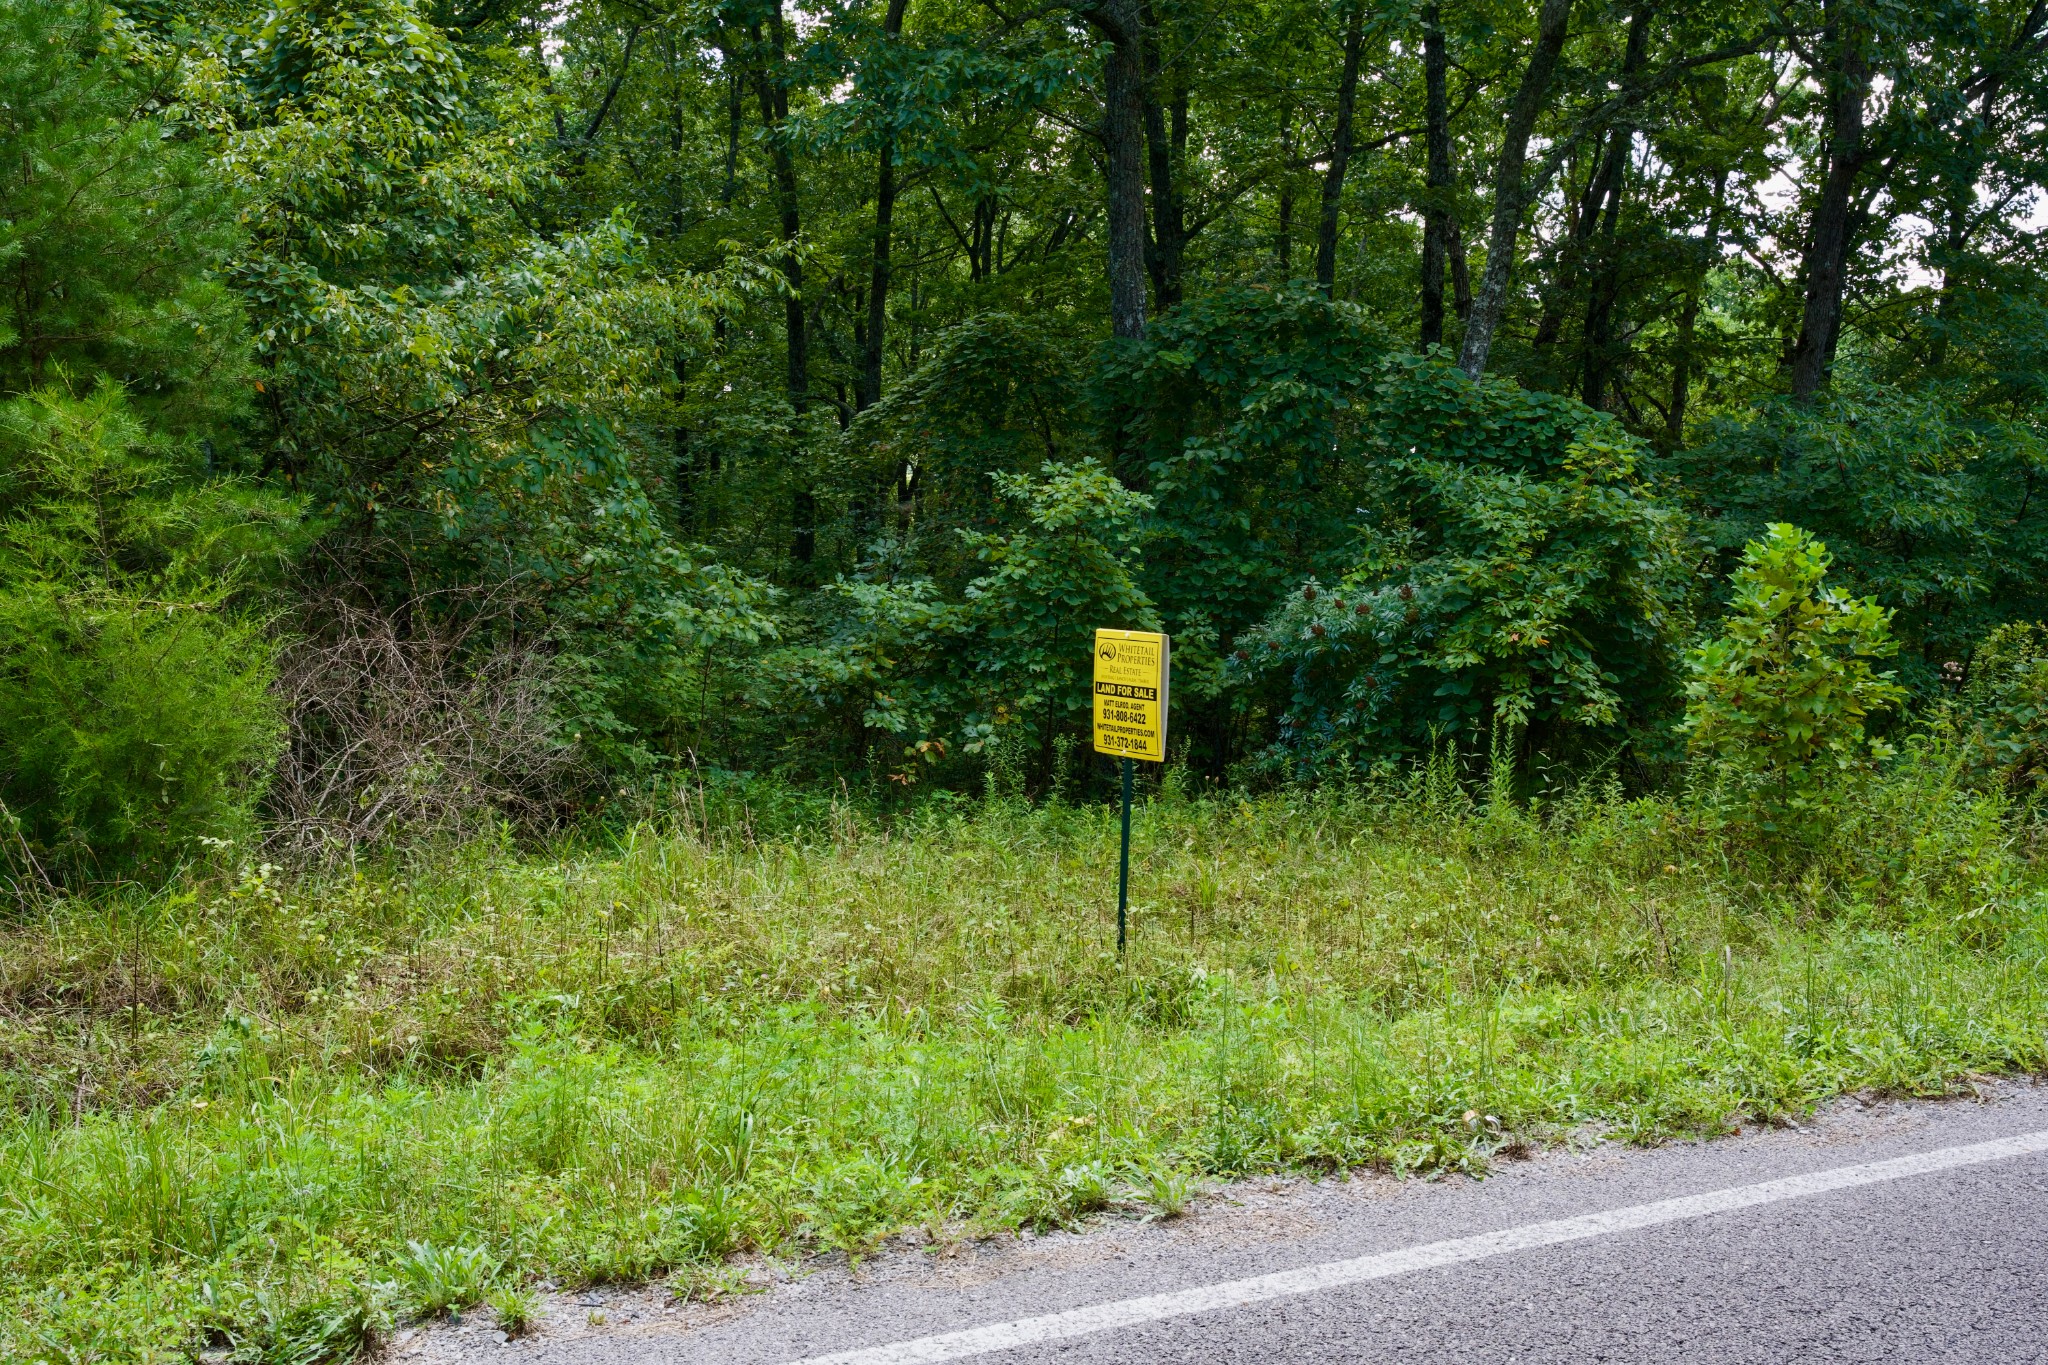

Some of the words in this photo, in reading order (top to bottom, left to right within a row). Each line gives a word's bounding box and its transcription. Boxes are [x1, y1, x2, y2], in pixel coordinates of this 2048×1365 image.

[1119, 643, 1154, 656] WHITETAIL
[1118, 653, 1155, 666] PROPERTIES
[1110, 665, 1121, 674] REAL
[1124, 667, 1141, 676] ESTATE
[1097, 683, 1115, 694] LAND
[1118, 686, 1132, 696] FOR
[1134, 688, 1154, 699] SALE
[1103, 709, 1146, 724] 931-808-6422
[1097, 723, 1155, 737] WHITETAILPROPERTIES.COM
[1104, 734, 1147, 750] 931-372-1844
